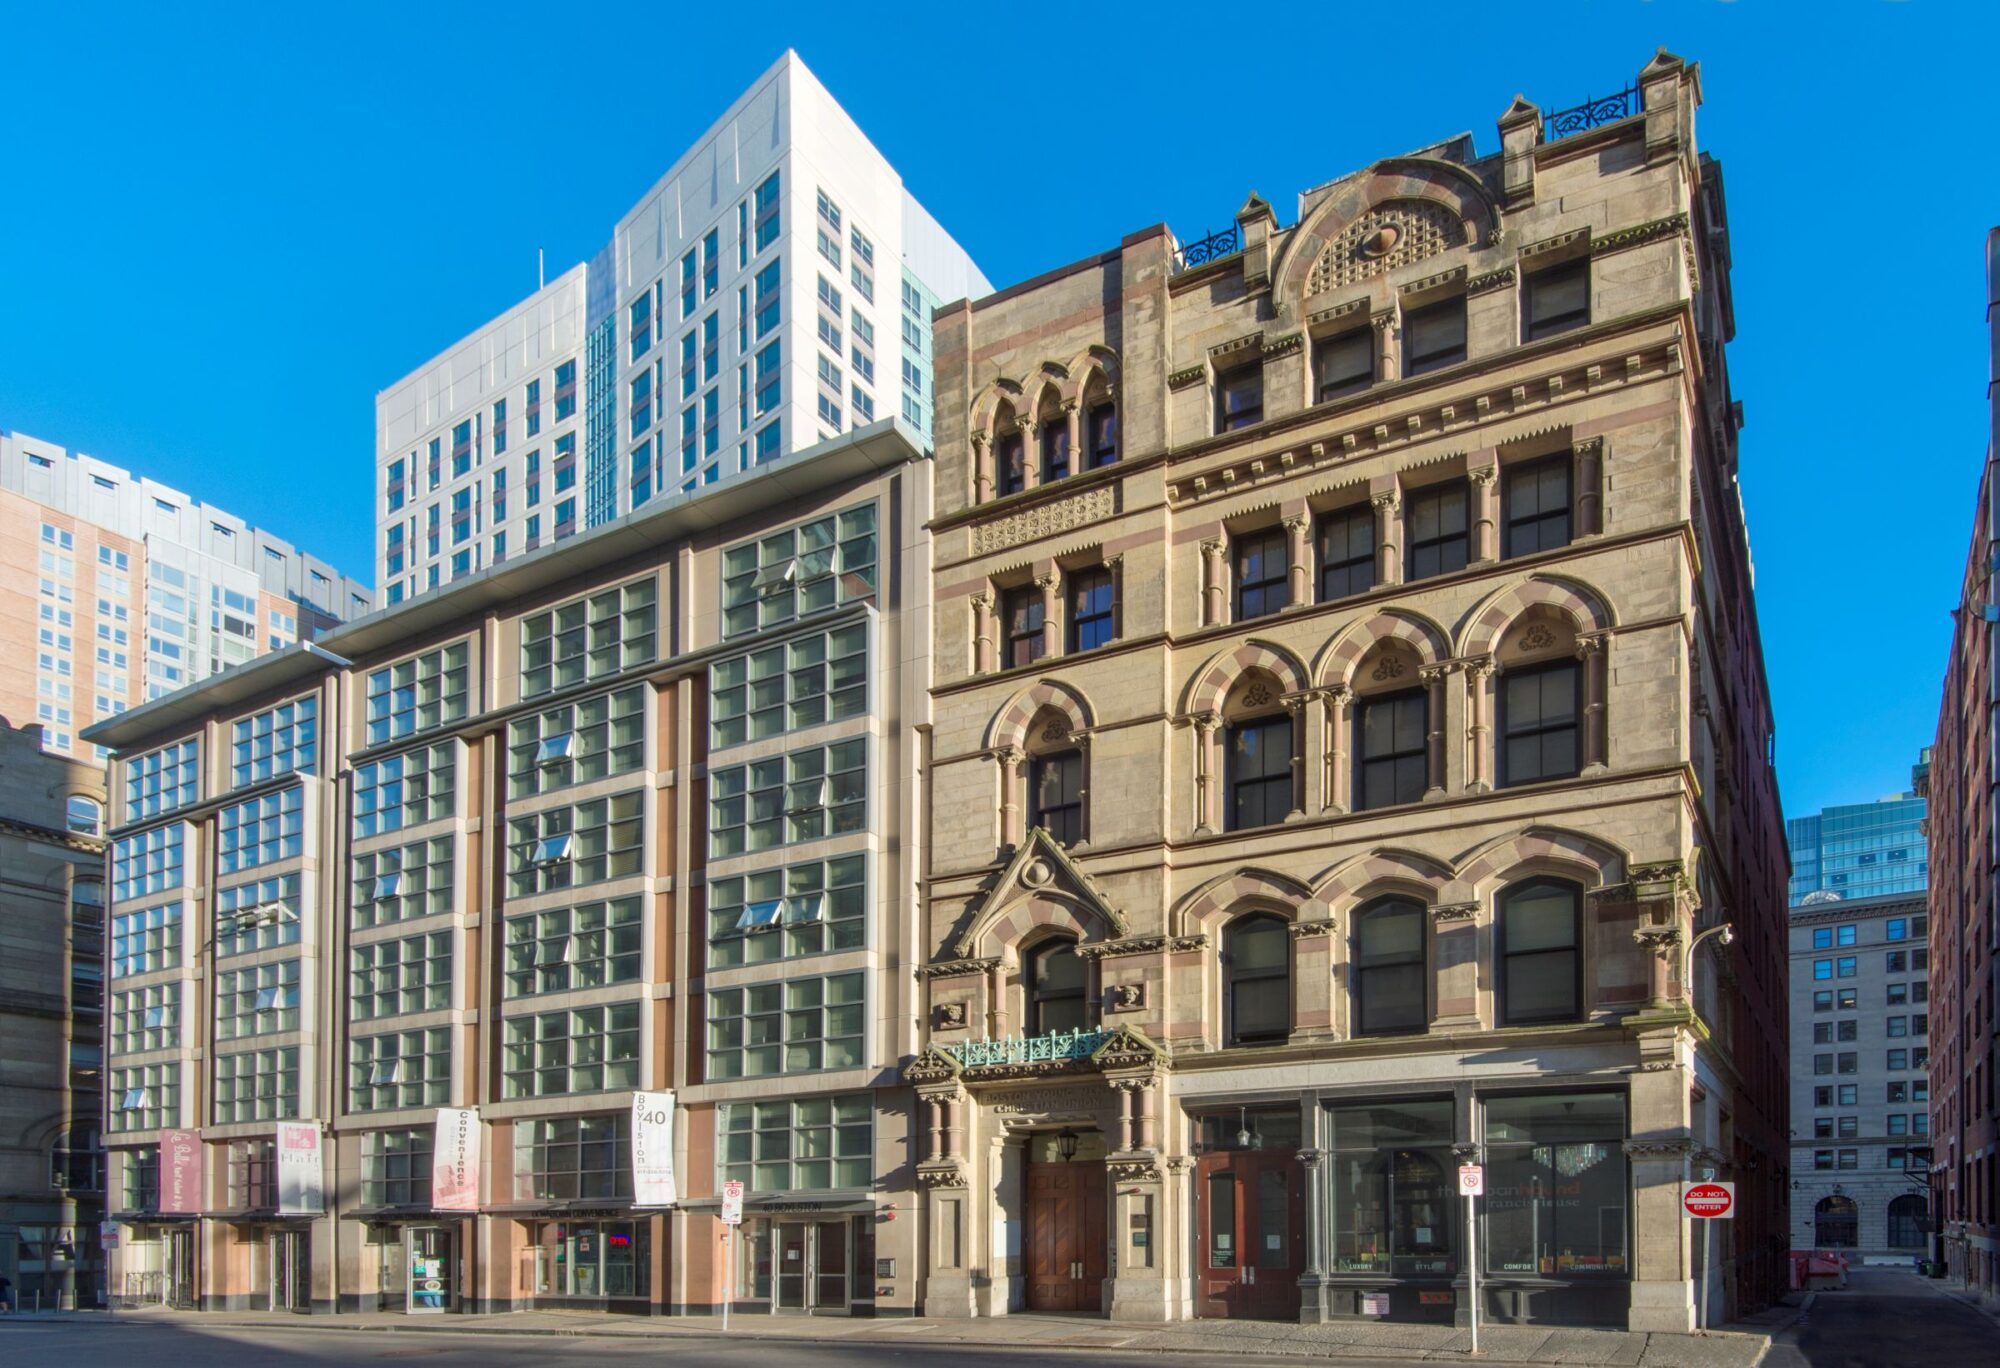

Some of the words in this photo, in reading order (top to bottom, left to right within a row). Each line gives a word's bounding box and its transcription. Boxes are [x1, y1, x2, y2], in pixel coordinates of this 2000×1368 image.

[456, 1111, 469, 1187] Convenience
[636, 1094, 646, 1164] Boylston
[643, 1110, 666, 1125] 40
